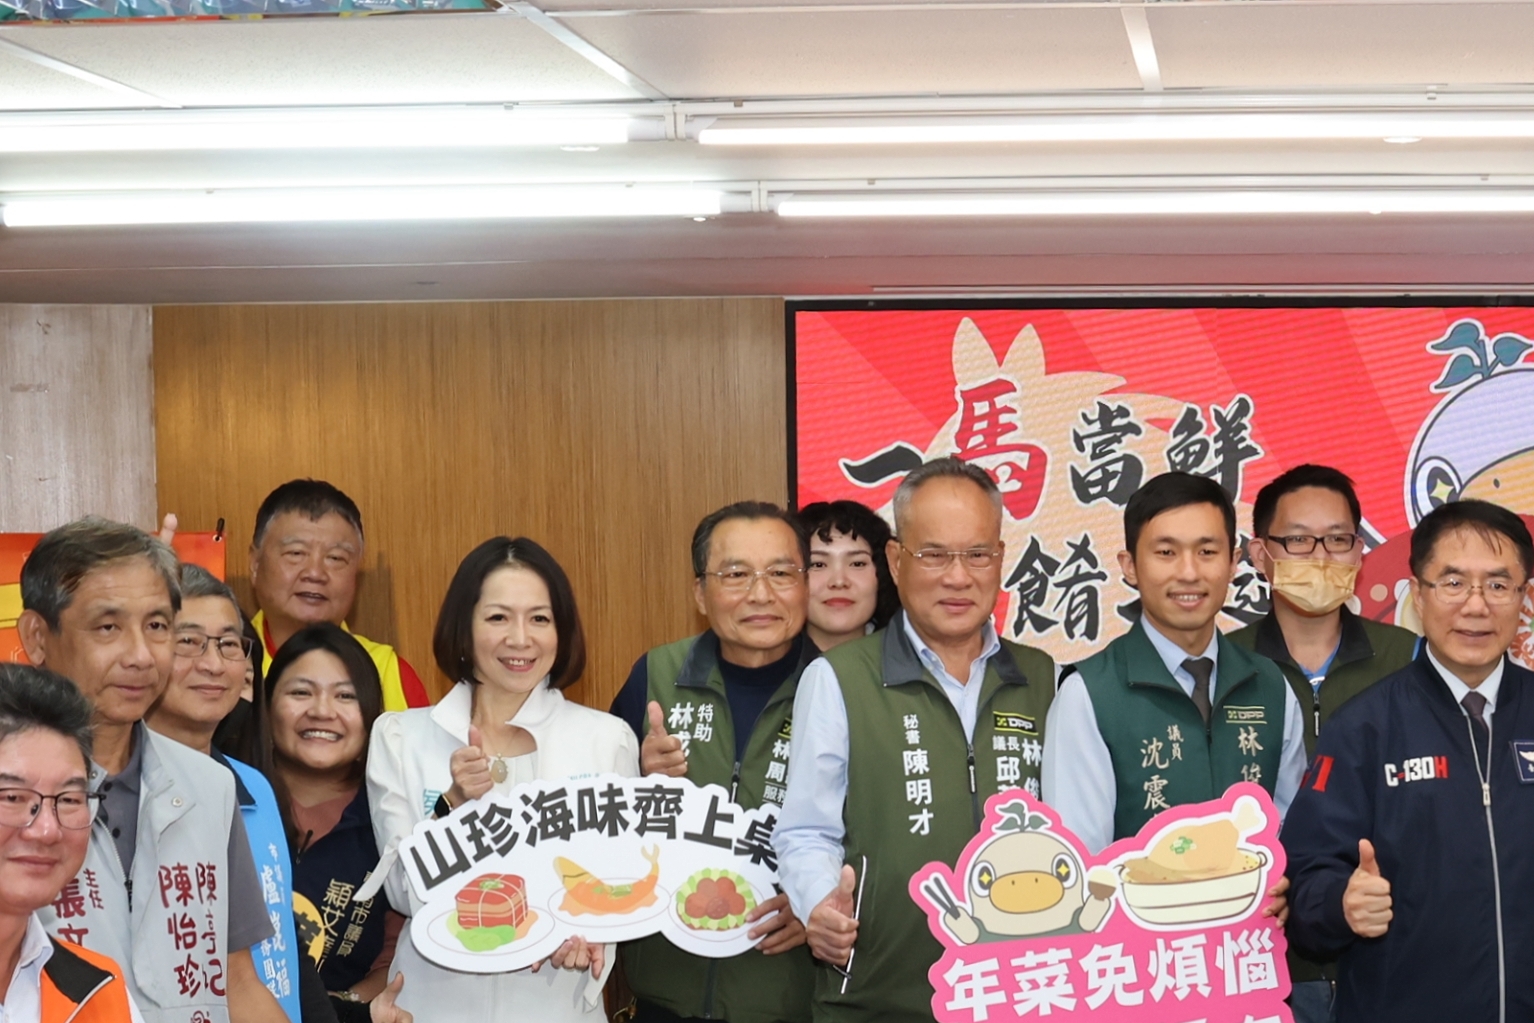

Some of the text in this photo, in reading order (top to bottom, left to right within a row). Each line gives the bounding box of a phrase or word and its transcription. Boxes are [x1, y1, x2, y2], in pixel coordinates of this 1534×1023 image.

[693, 703, 714, 742] 特助
[903, 714, 920, 744] 秘書
[1007, 717, 1033, 730] DPP
[1237, 709, 1265, 719] DPP
[992, 735, 1020, 751] 議長
[1166, 724, 1184, 761] 議員
[1140, 737, 1171, 818] 沈震
[1384, 756, 1449, 787] C-130H
[902, 748, 934, 836] 陳明才
[410, 783, 779, 891] 山珍海味齊上桌
[83, 868, 104, 910] 主任
[158, 862, 202, 998] 陳怡珍
[943, 927, 1280, 1022] 年菜免煩惱
